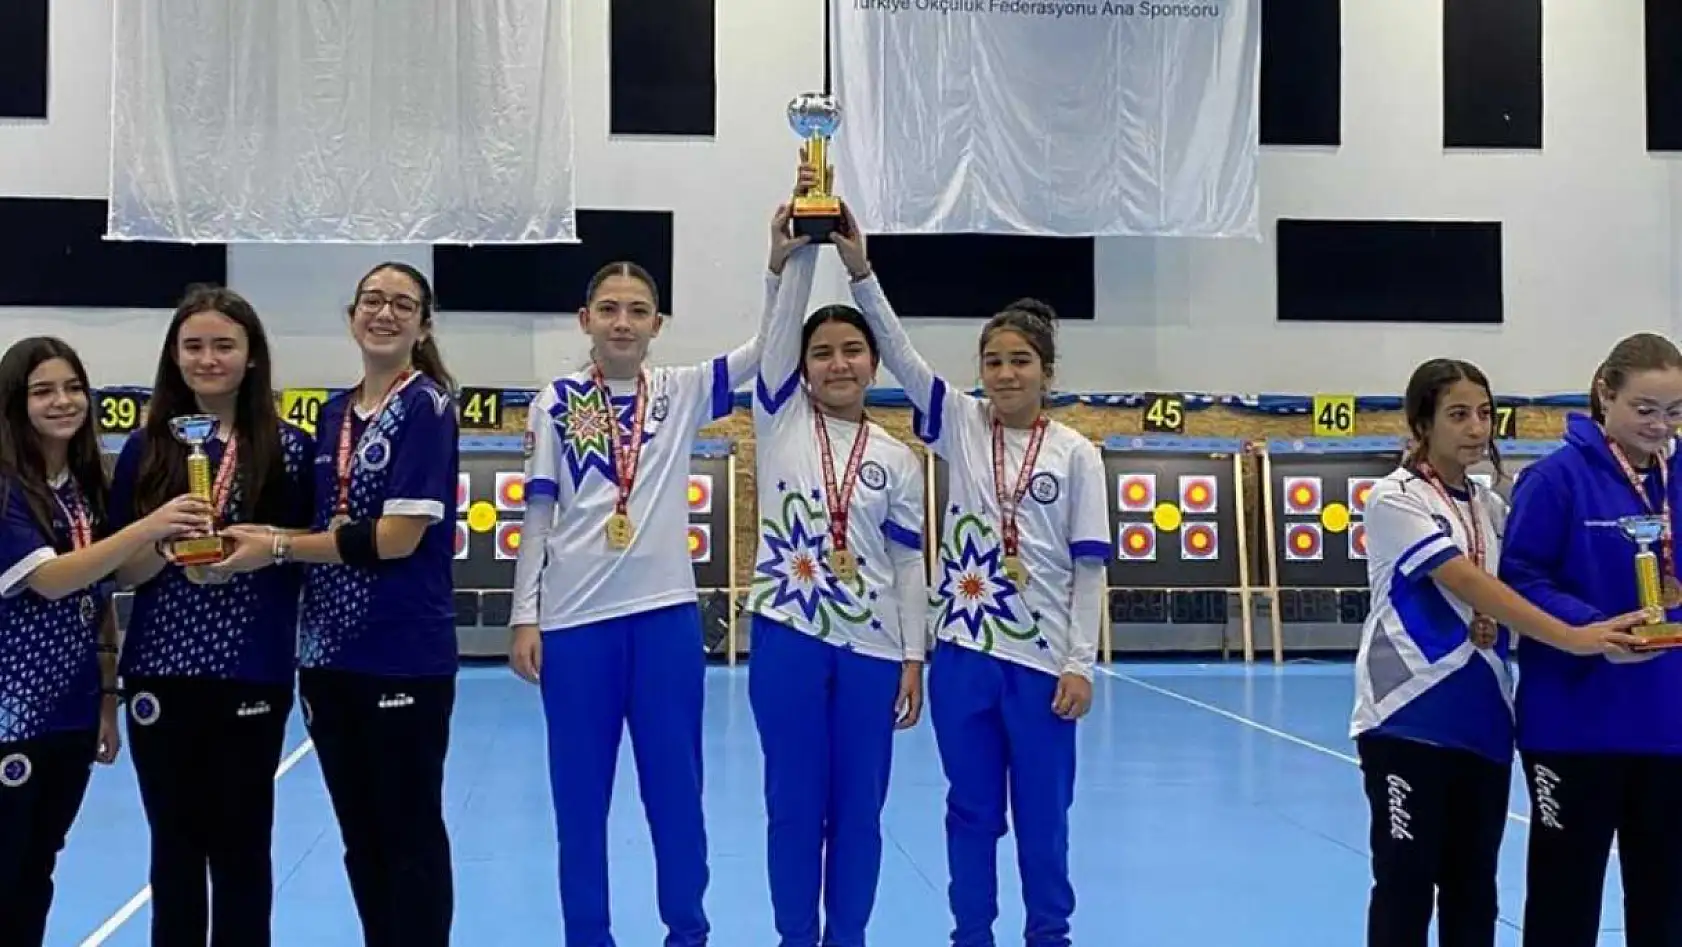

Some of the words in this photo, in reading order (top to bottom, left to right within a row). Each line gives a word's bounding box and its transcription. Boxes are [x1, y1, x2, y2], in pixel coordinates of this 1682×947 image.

[915, 0, 986, 15] Okçuluk
[989, 0, 1097, 18] Federasyonu
[1101, 0, 1135, 16] Ana
[1139, 0, 1219, 20] Sponsoru
[101, 397, 136, 428] 39
[288, 396, 320, 425] 40
[463, 393, 497, 424] 41
[1147, 399, 1182, 428] 45
[1318, 402, 1350, 431] 46
[1496, 407, 1512, 436] 7
